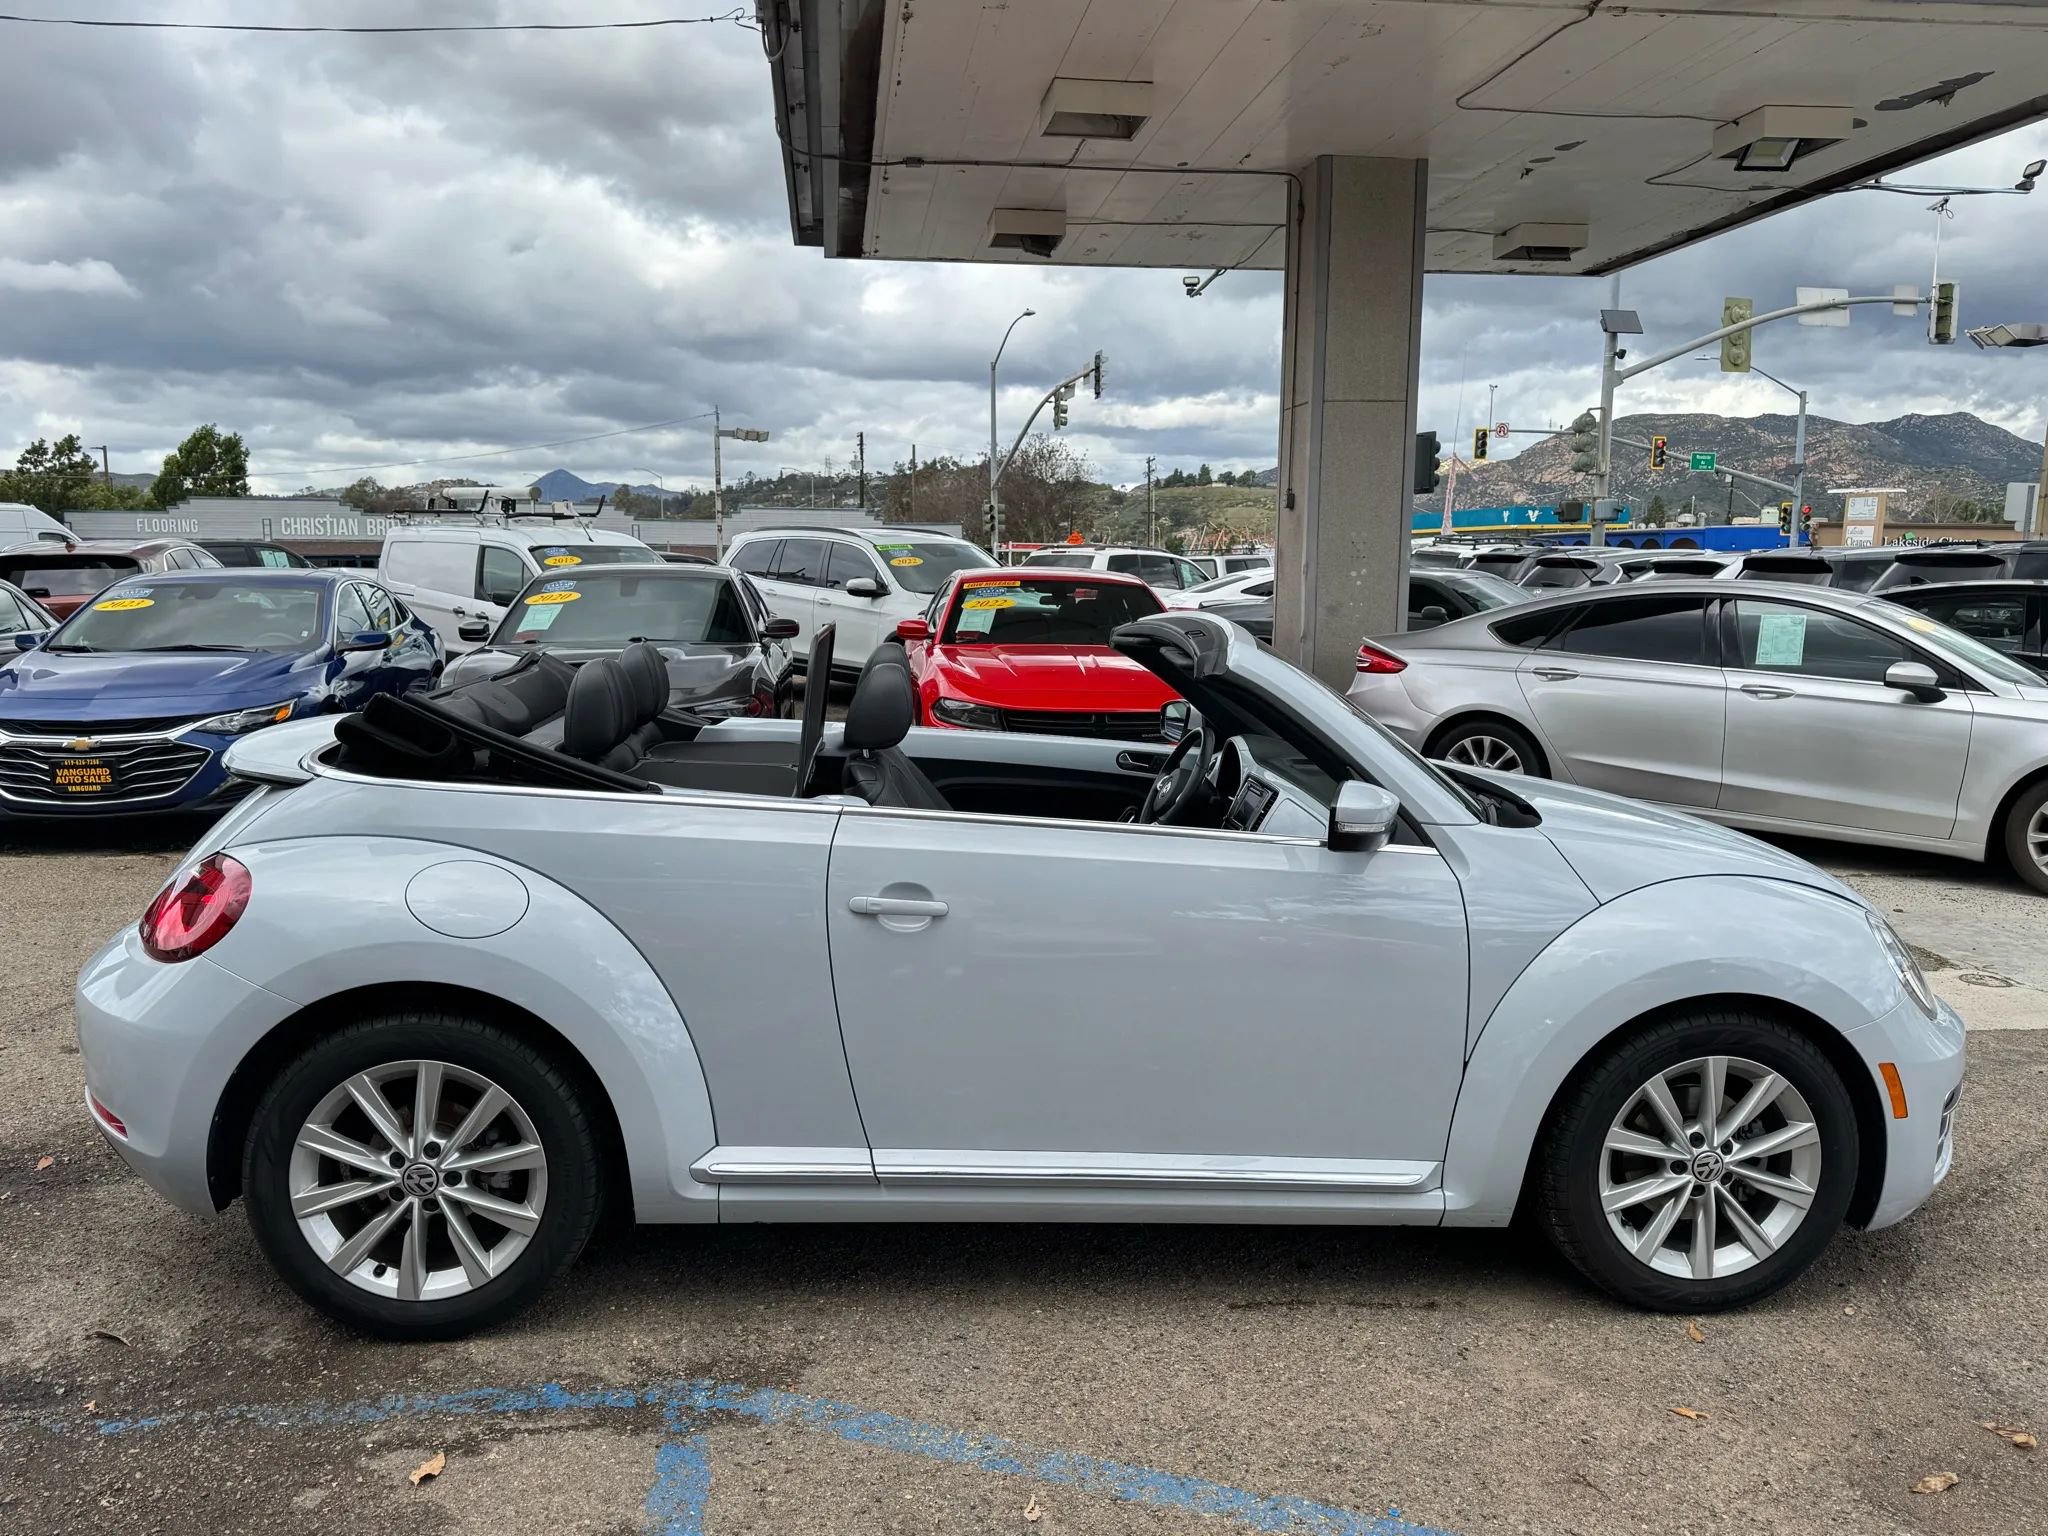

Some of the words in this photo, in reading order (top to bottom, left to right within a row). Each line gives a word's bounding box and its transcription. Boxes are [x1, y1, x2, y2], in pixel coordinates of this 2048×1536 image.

[136, 518, 199, 533] FLOORING
[281, 514, 359, 536] CHRISTIAN
[1884, 536, 1936, 547] Lakeside
[552, 557, 575, 565] 2015
[532, 593, 573, 603] 2020
[969, 599, 1008, 609] 2022
[56, 768, 110, 777] VANGUARD
[55, 776, 82, 784] AUTO
[83, 775, 112, 783] SALES
